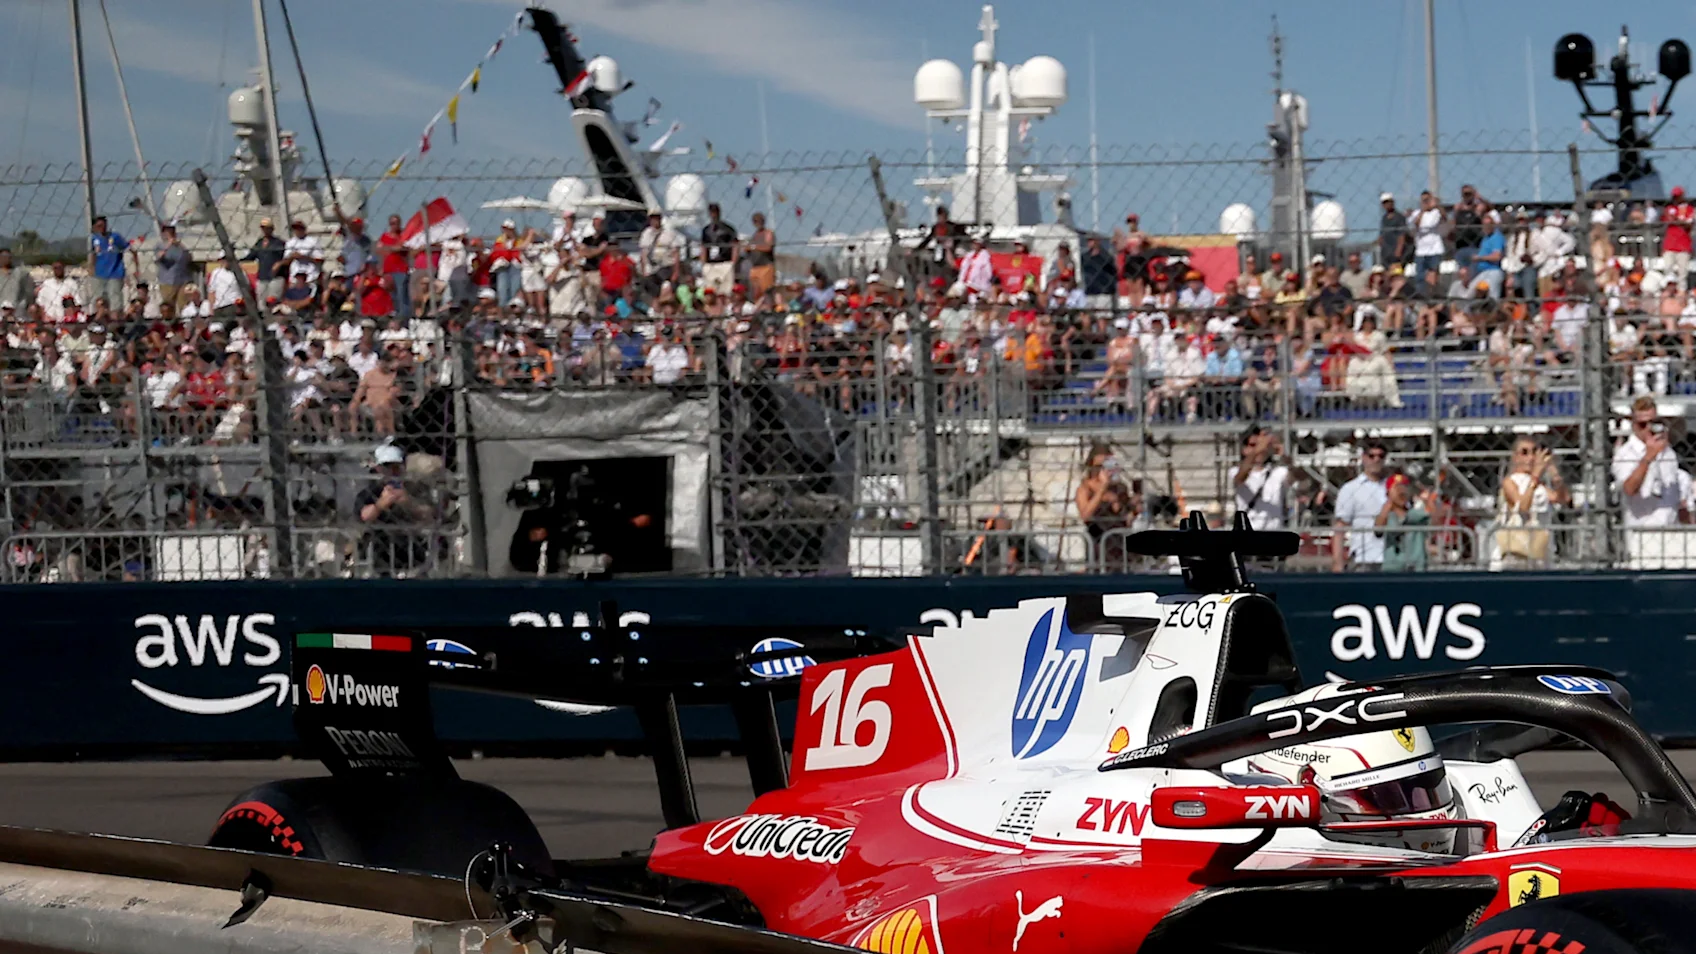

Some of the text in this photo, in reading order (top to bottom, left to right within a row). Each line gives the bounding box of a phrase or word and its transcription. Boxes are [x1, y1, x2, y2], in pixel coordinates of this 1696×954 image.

[134, 613, 281, 668] aws
[1330, 602, 1487, 661] aws
[325, 673, 399, 708] V-Power
[1013, 605, 1089, 759] hp
[804, 663, 893, 771] 16
[1076, 797, 1151, 836] ZYN
[1244, 795, 1311, 819] ZYN
